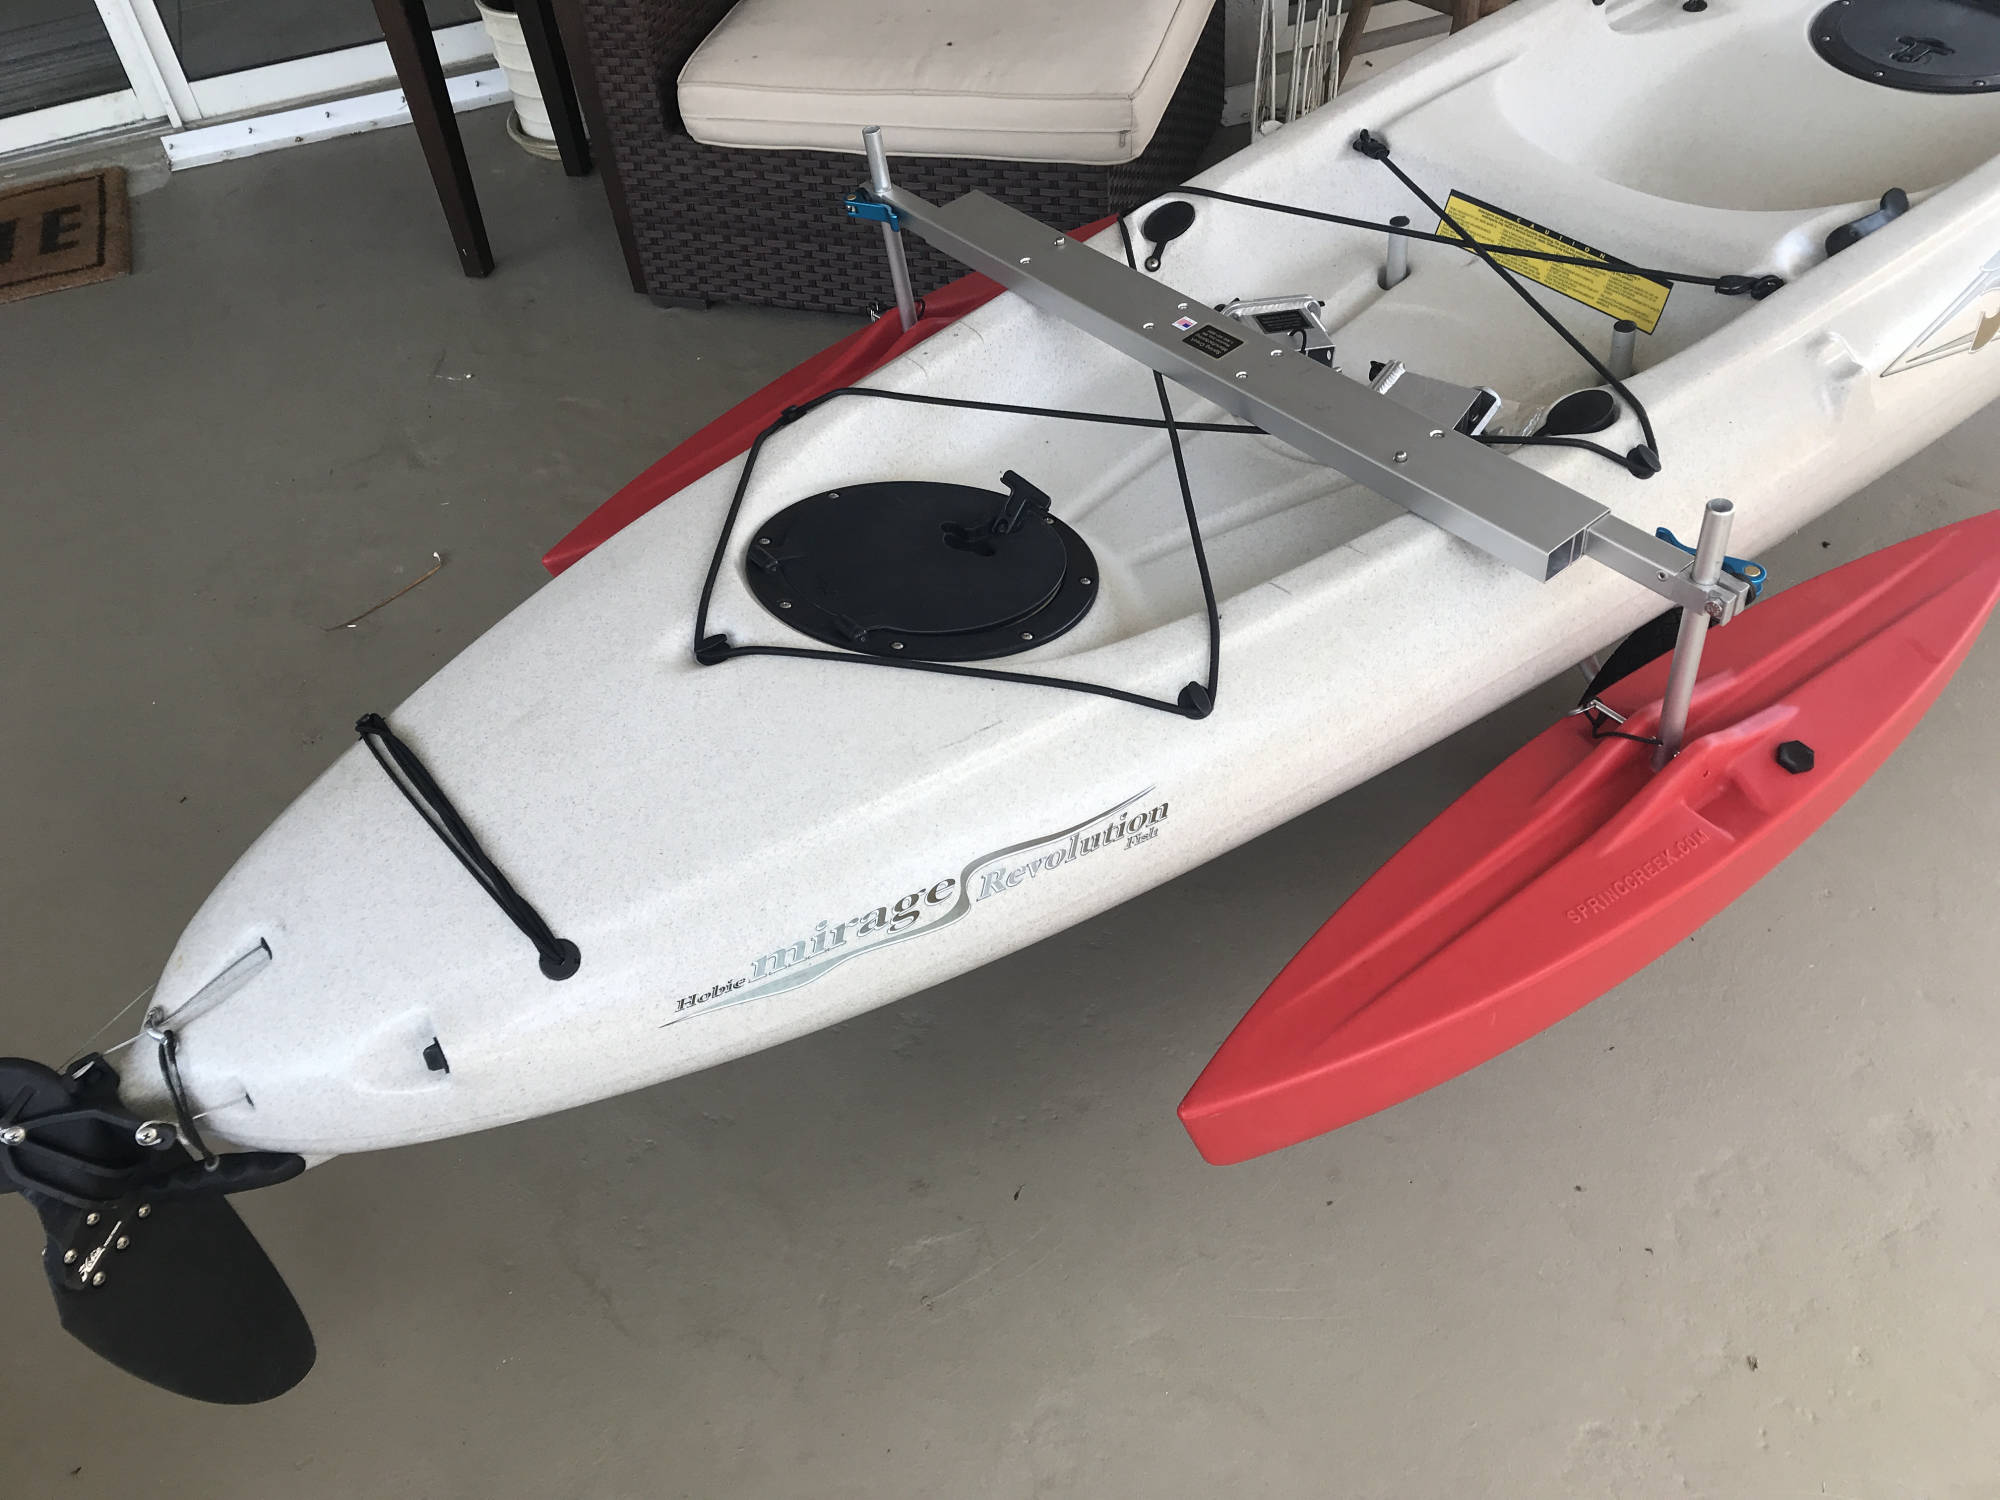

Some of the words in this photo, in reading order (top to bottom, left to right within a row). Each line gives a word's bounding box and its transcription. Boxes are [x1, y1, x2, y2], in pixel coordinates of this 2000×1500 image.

[1516, 217, 1607, 259] CAUTION
[675, 976, 747, 1012] Hobie
[749, 877, 957, 983] mirage
[976, 802, 1169, 902] Revolution
[1566, 830, 1713, 925] SPRINGCREEK.COM
